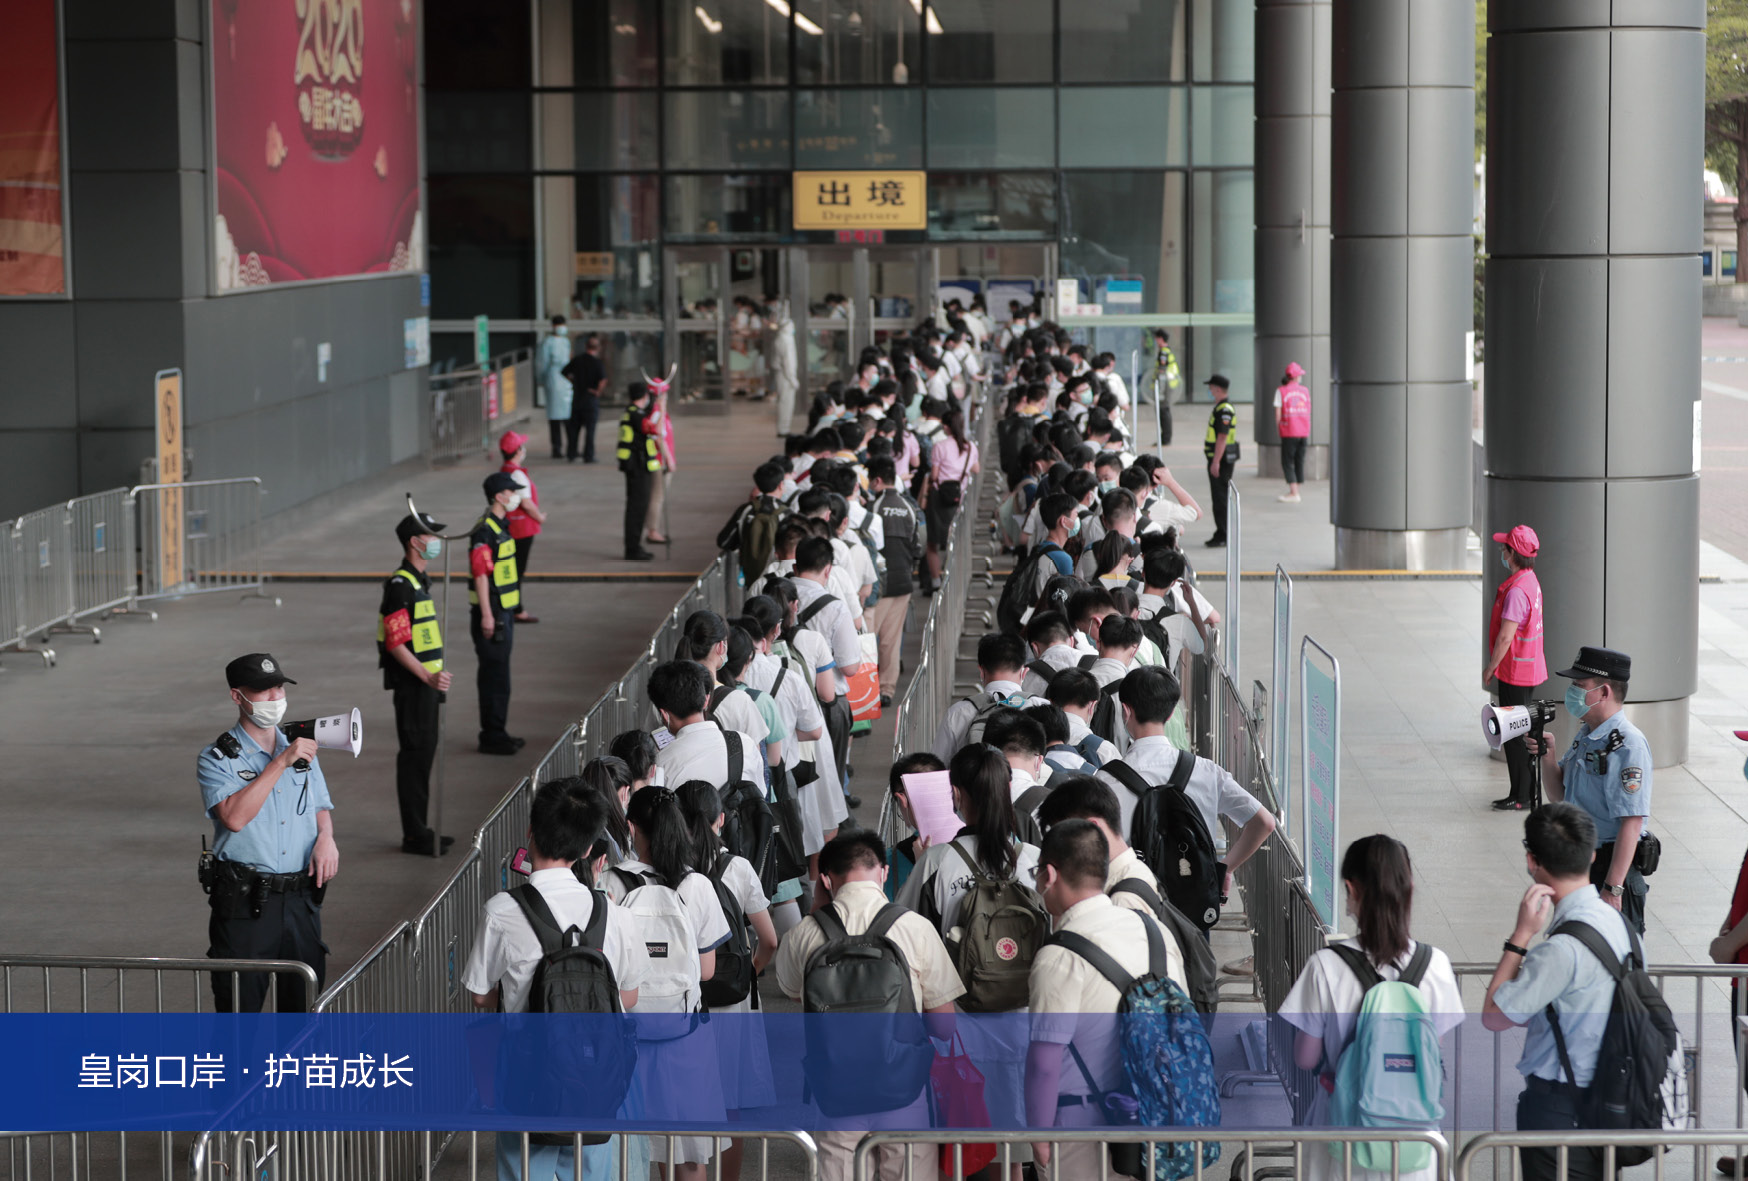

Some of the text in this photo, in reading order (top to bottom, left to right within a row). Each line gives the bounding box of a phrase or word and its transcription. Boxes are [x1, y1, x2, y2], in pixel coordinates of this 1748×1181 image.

[294, 0, 364, 85] 2020
[817, 179, 905, 207] 出境
[821, 210, 900, 223] Departure
[1509, 718, 1529, 731] POLICE
